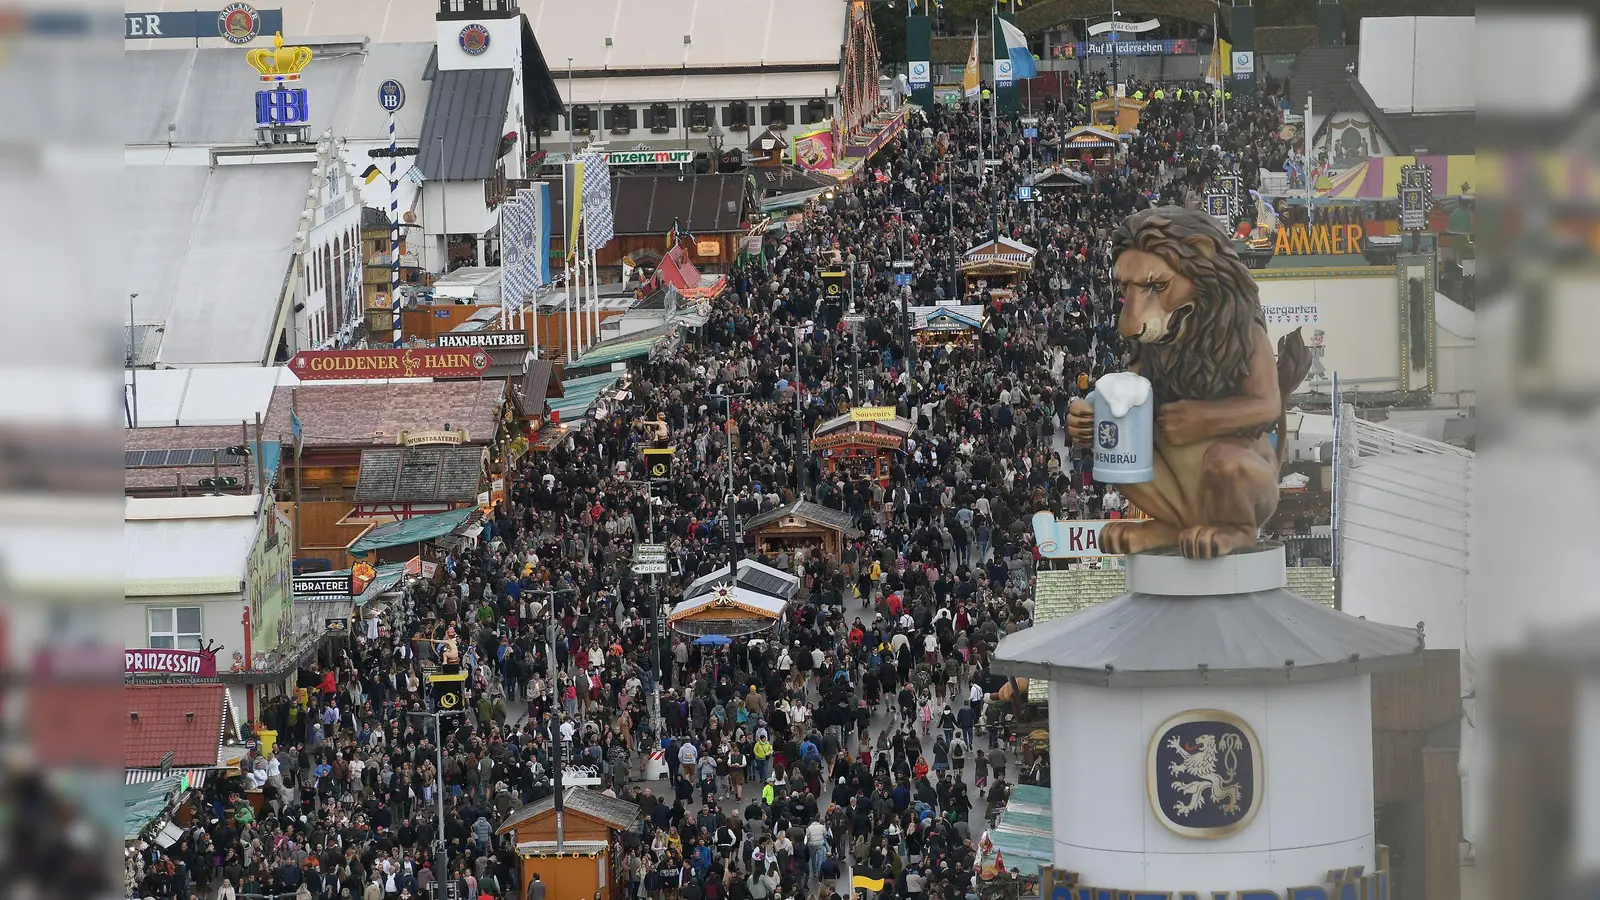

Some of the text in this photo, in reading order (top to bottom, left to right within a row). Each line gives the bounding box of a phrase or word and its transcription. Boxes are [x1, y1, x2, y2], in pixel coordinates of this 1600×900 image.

[220, 3, 258, 21] PAULANER
[223, 30, 256, 43] MÜNCHEN
[1088, 43, 1163, 55] Auf Wiedersehen
[257, 90, 301, 124] HB
[384, 95, 398, 107] HB
[1274, 223, 1363, 256] AMMER
[439, 334, 525, 348] HAXNBRATEREI
[310, 354, 471, 371] GOLDENER HAHN
[407, 436, 459, 445] WURSTBRATEREI
[814, 439, 848, 448] Souvenirs
[125, 652, 200, 674] PRINZESSIN
